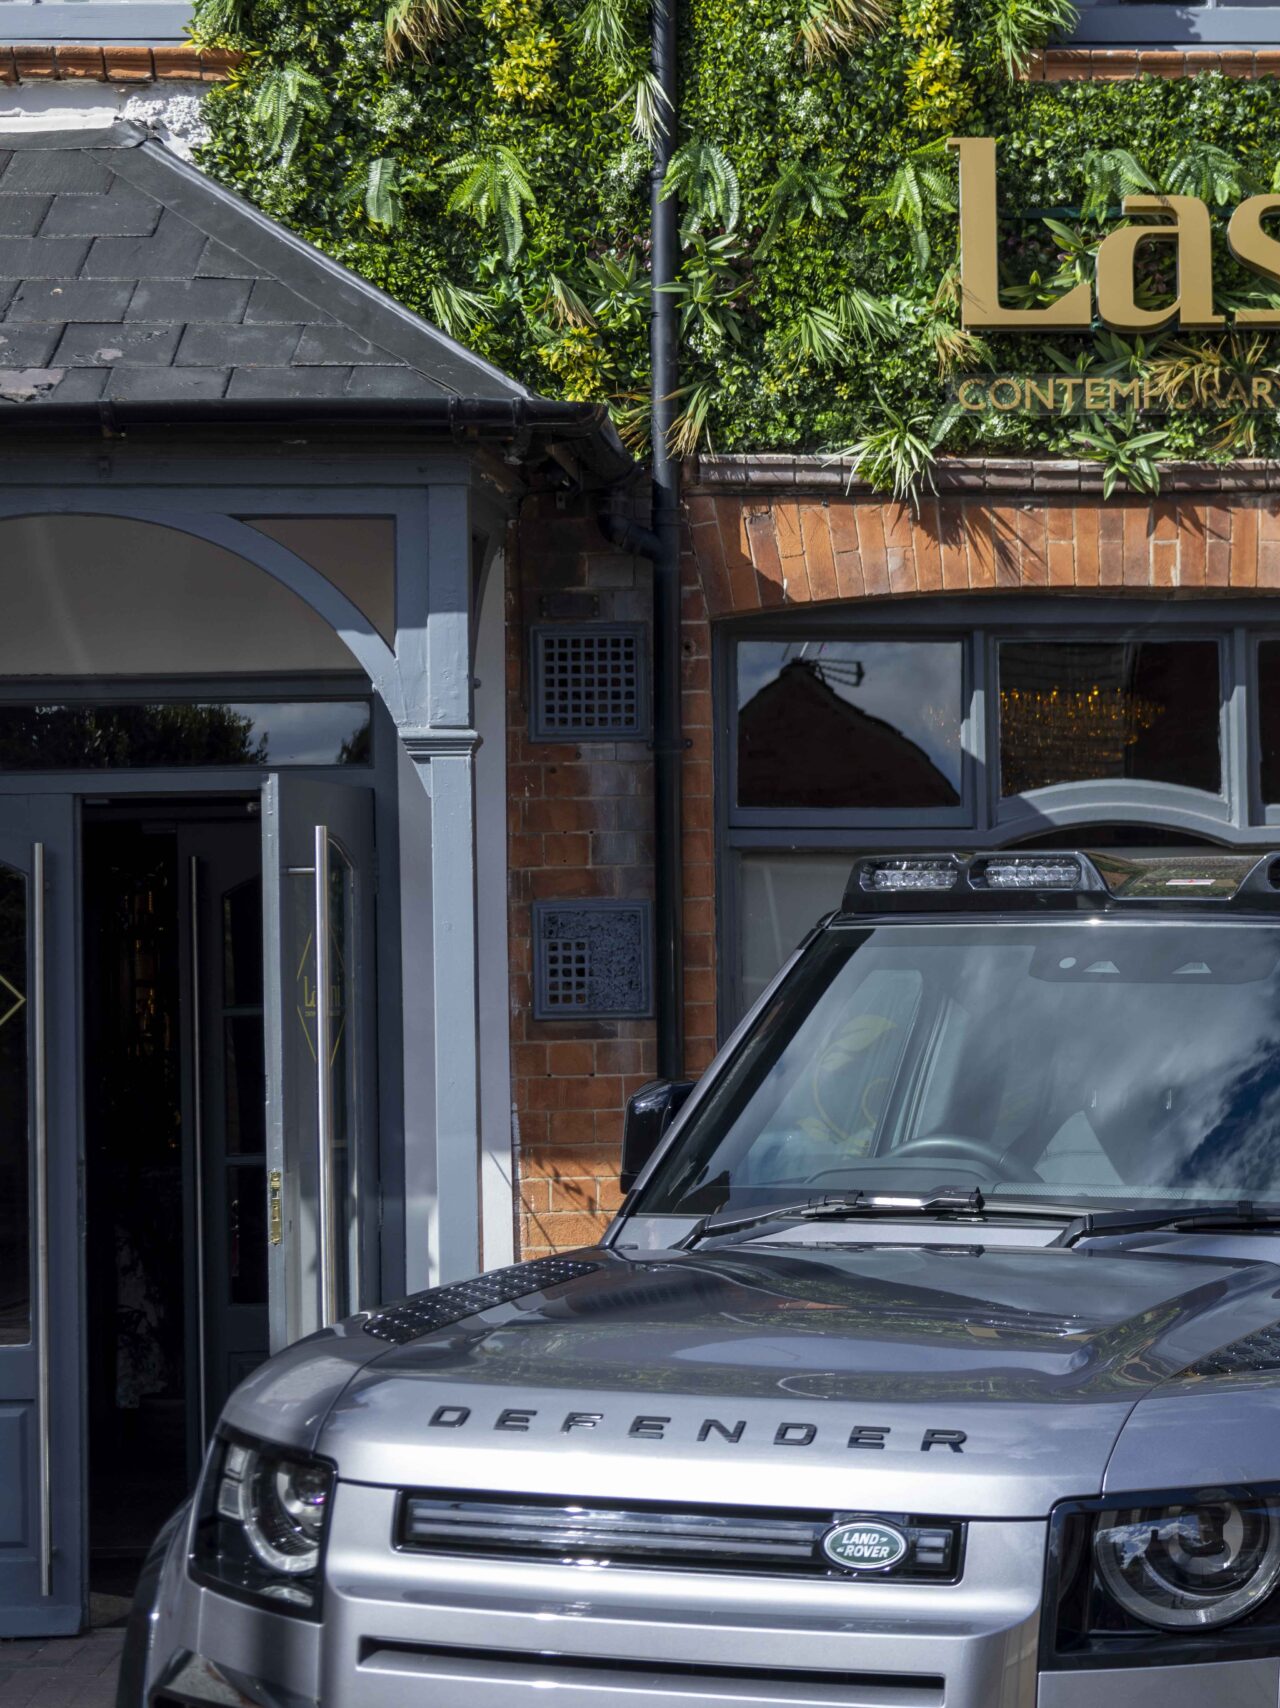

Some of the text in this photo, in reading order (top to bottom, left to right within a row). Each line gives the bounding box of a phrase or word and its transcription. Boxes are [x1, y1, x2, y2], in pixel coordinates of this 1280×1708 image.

[428, 1404, 968, 1454] DEFENDER
[842, 1532, 880, 1545] LAND
[844, 1544, 890, 1558] ROVER
